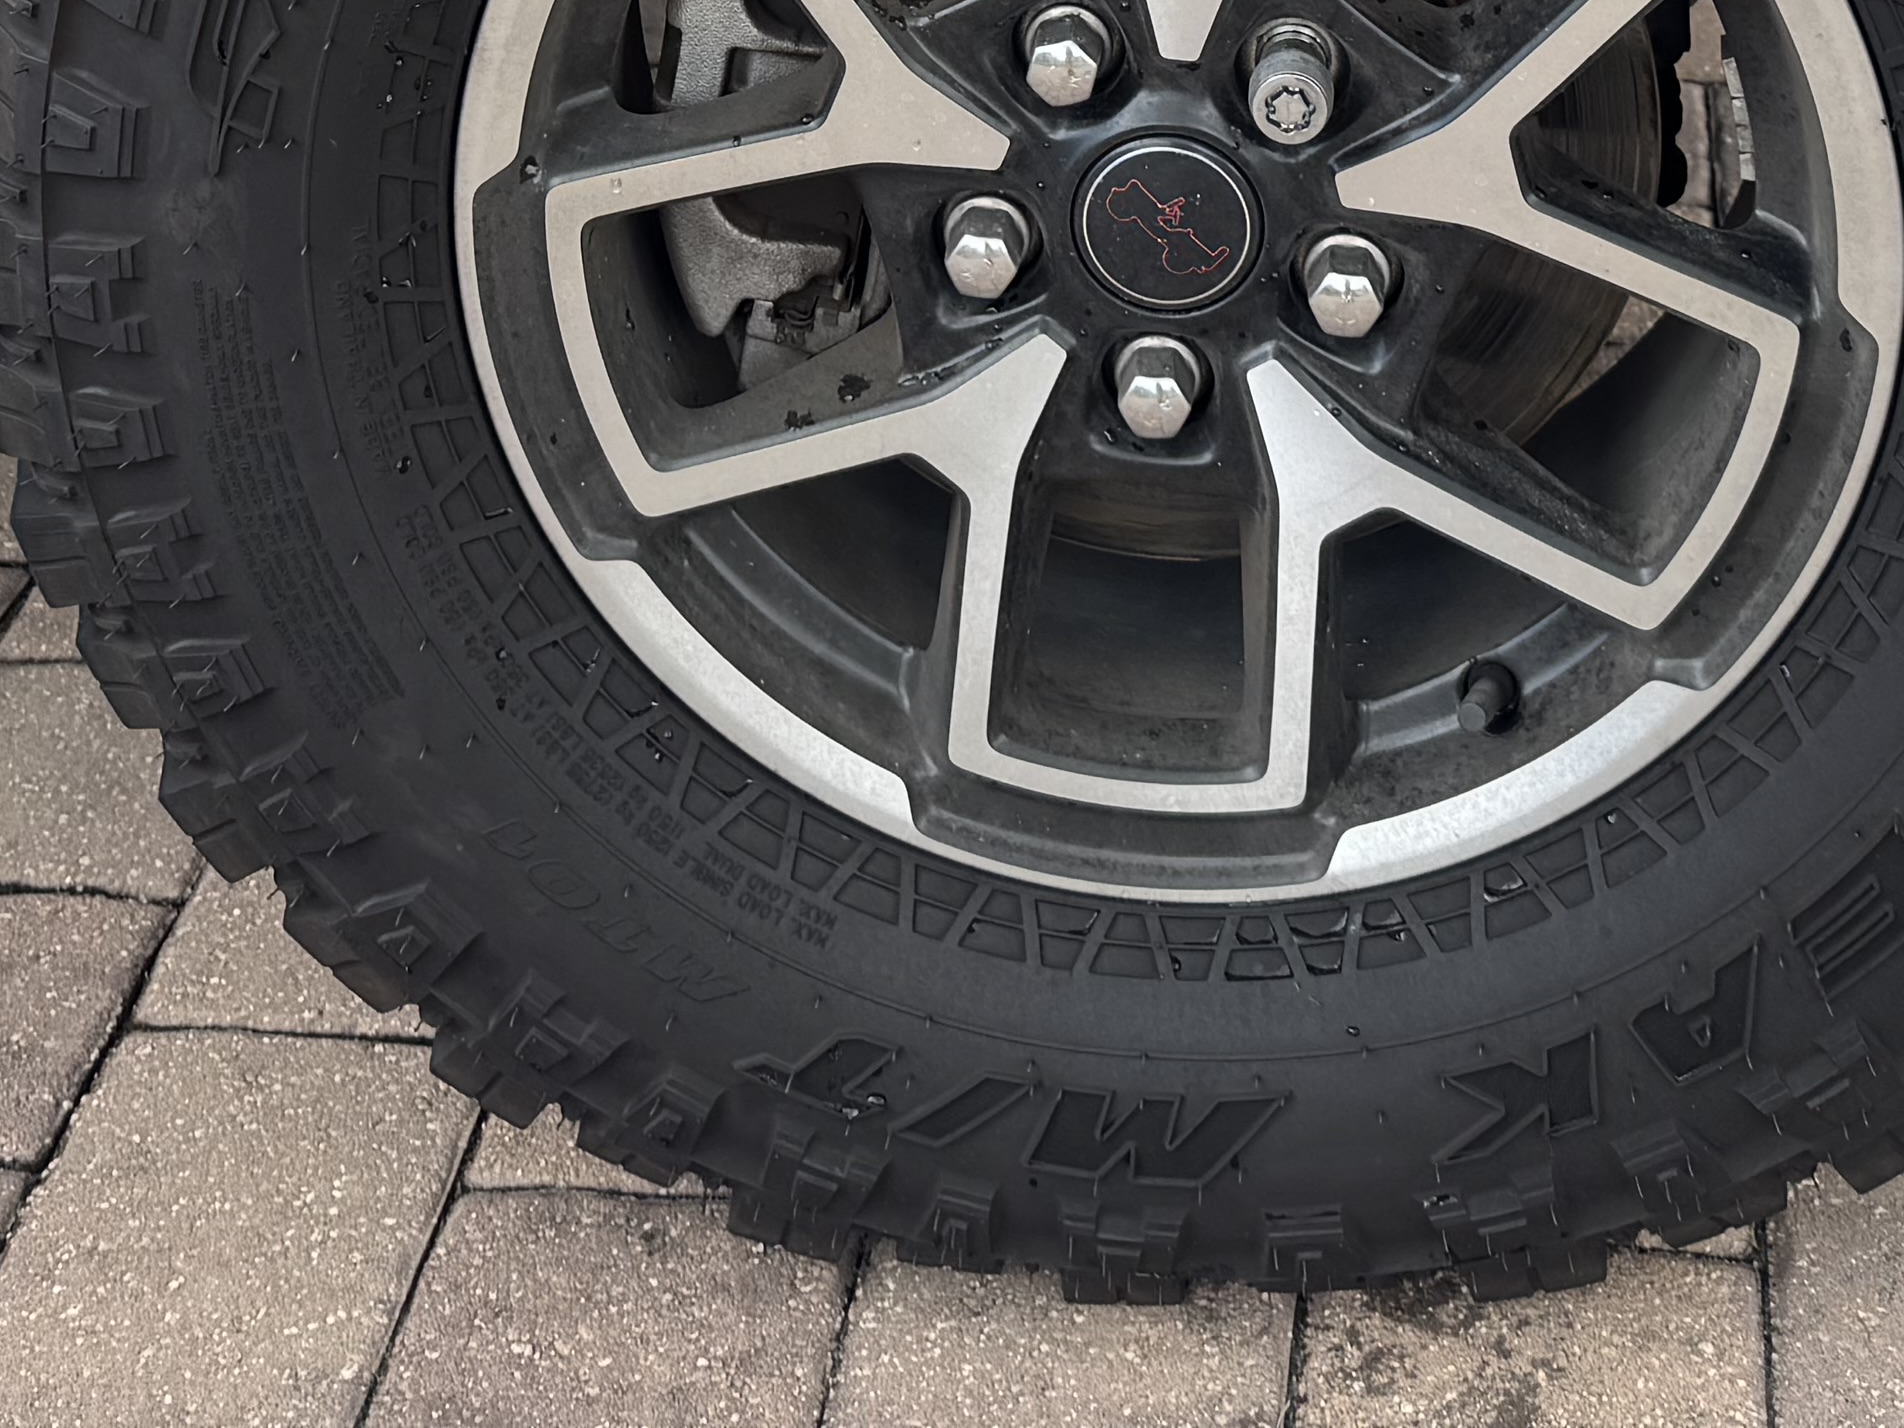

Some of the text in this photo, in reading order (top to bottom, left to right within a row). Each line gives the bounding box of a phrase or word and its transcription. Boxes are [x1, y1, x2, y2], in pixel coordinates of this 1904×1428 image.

[694, 840, 747, 882] DUAL
[733, 888, 786, 928] LOAD
[742, 870, 796, 909] LOAD
[739, 1031, 1296, 1190] M/T
